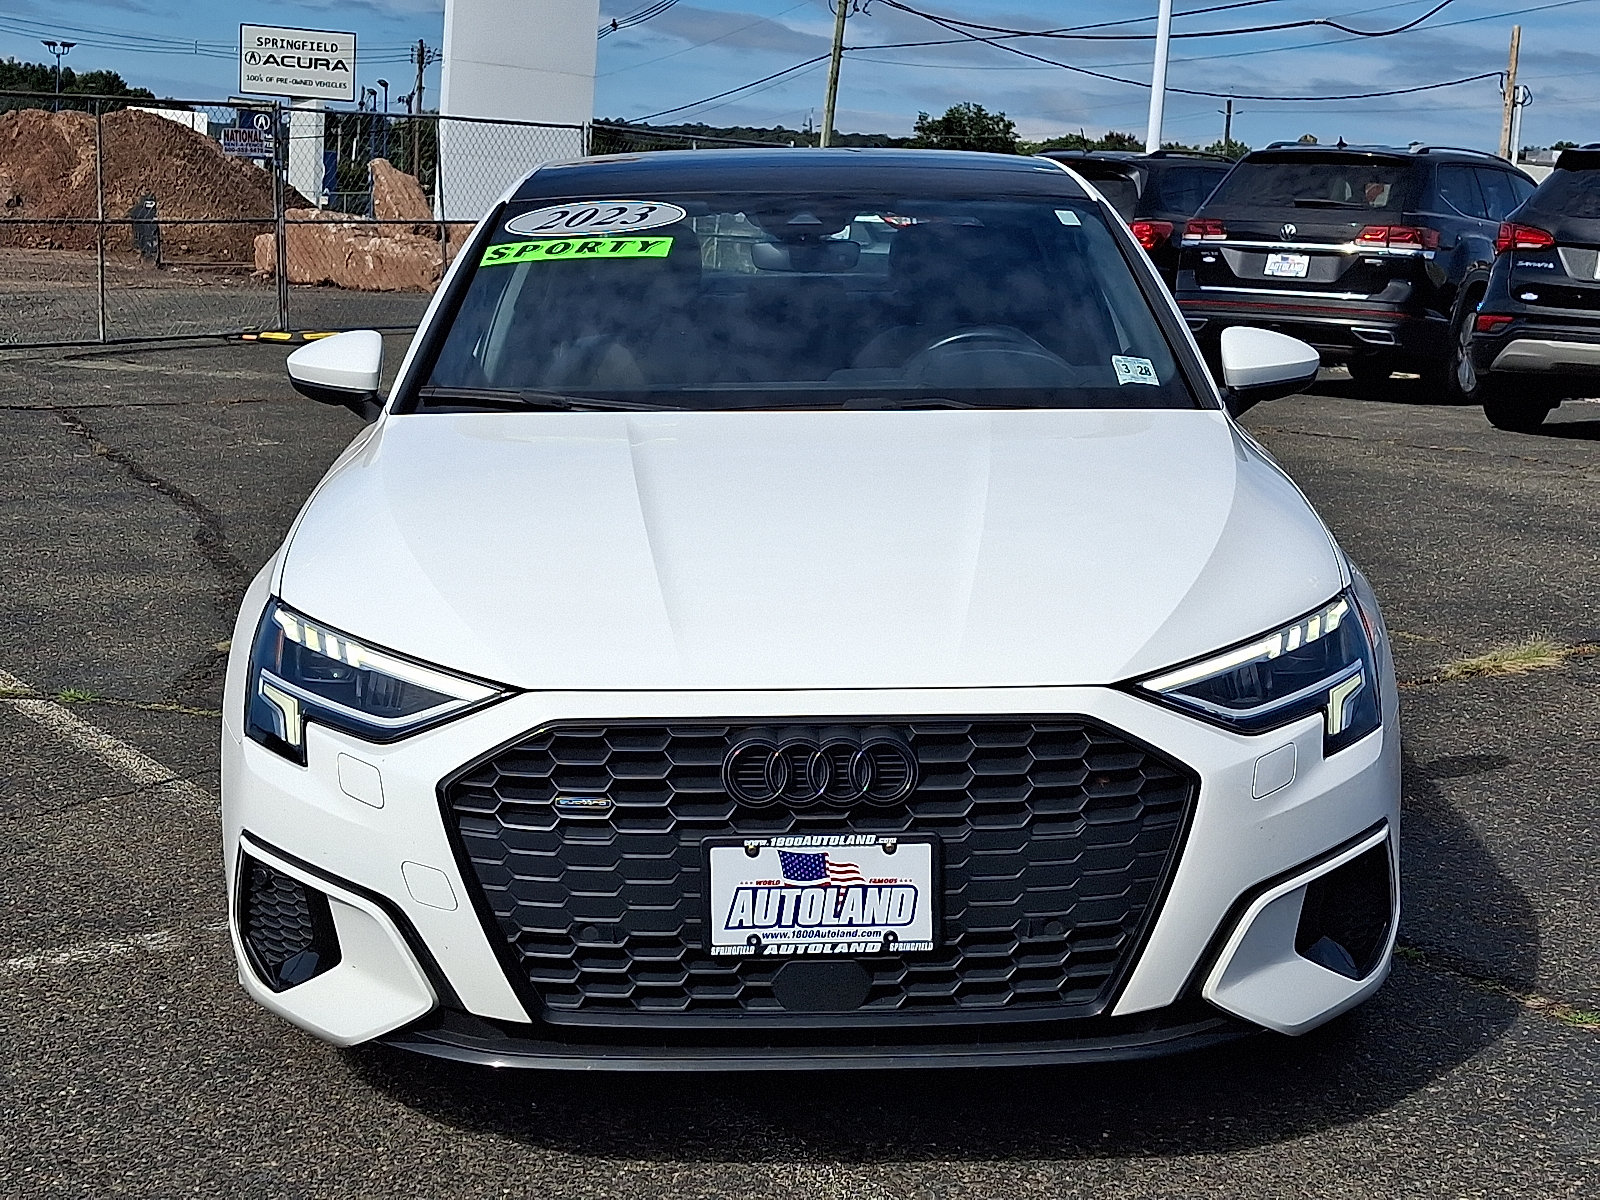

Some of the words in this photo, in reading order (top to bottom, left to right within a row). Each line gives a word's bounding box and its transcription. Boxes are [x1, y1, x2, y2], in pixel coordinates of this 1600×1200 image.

[256, 36, 339, 53] SPRINGFIELD
[262, 53, 350, 73] ACURA
[275, 77, 314, 87] PRE-OWNED
[315, 81, 348, 90] VEHICLES
[223, 129, 264, 143] NATIONAL
[532, 206, 658, 232] 2023
[485, 239, 666, 262] SPORTY
[1268, 261, 1305, 272] AUTOLAND
[1122, 363, 1131, 374] 3
[1137, 364, 1152, 377] 28
[724, 886, 919, 930] AUTOLAND
[761, 929, 882, 940] www.1800Autoland.com
[762, 942, 882, 956] AUTOLAND
[889, 942, 934, 952] SPRINGFIELD
